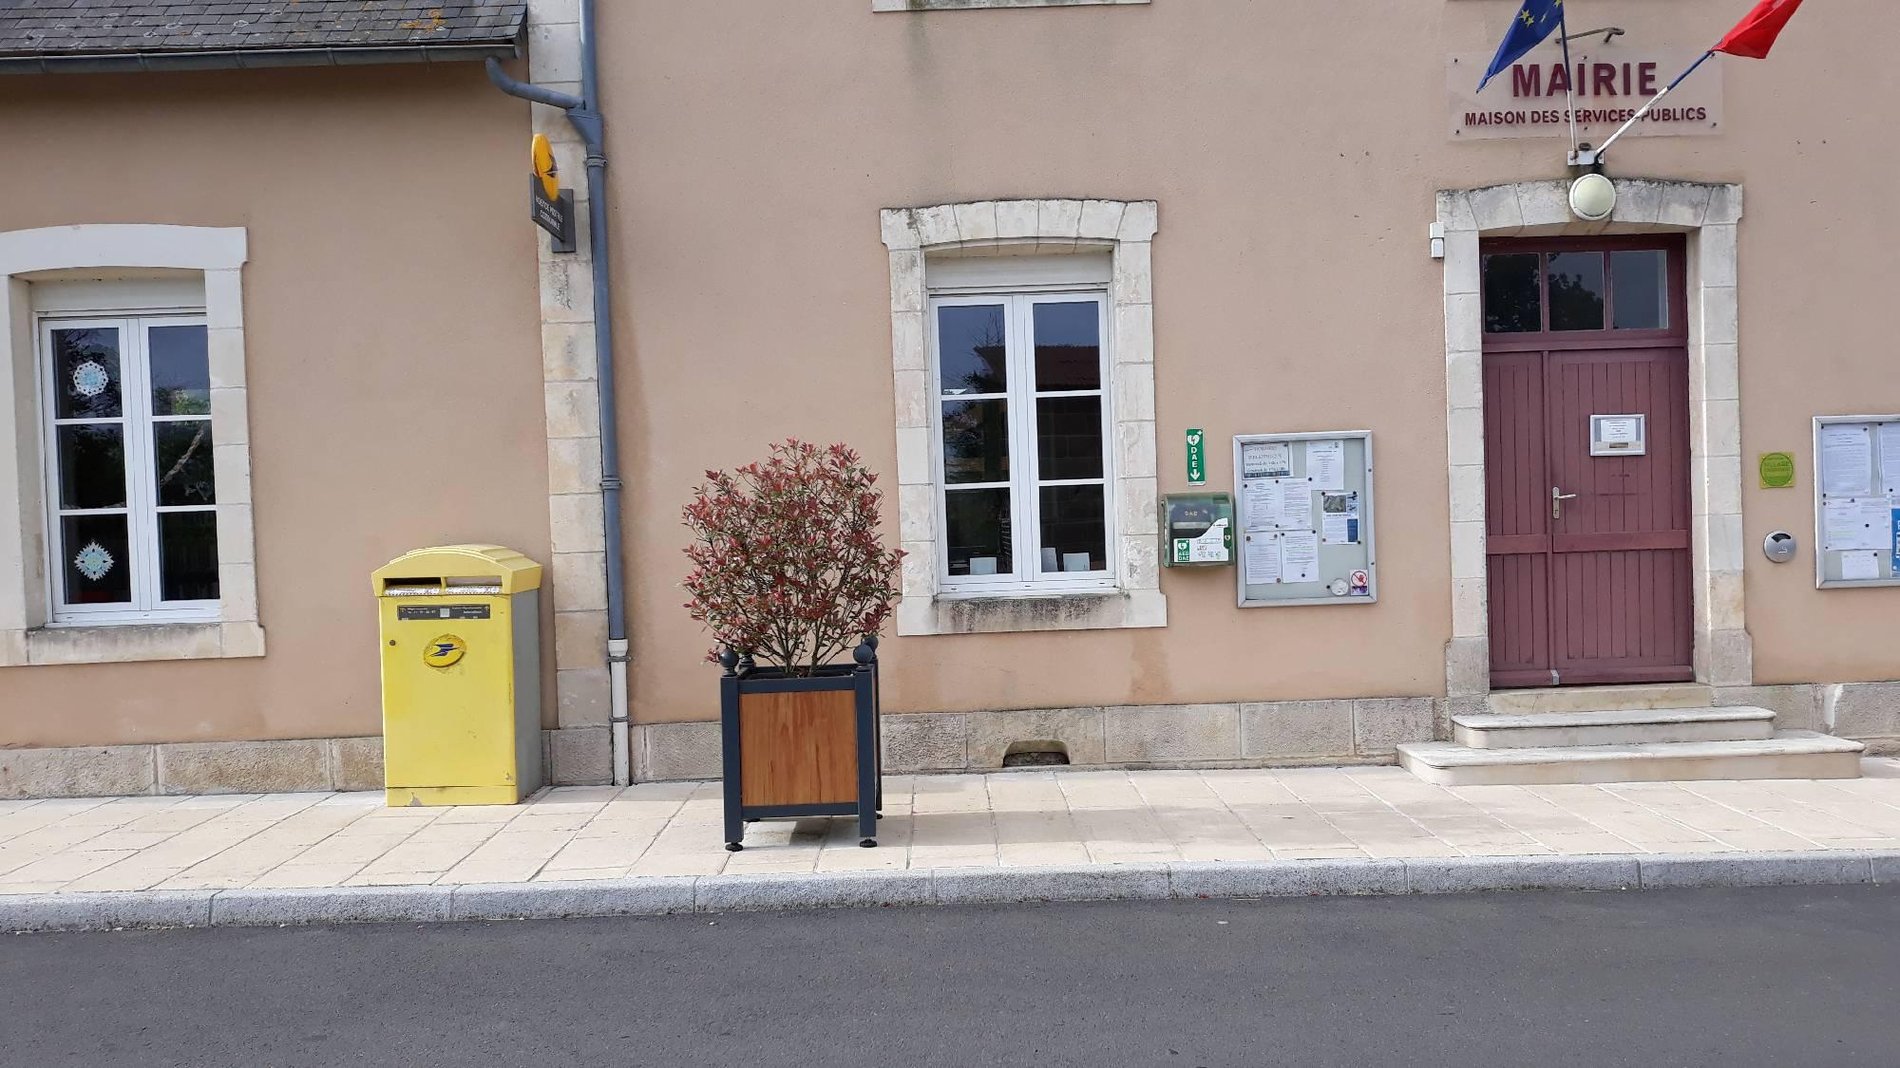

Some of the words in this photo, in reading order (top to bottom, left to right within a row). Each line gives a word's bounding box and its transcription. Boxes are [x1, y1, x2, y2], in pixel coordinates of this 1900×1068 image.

[1512, 62, 1659, 98] MAIRIE
[1465, 110, 1527, 126] MAISON
[1531, 109, 1560, 124] DES
[1564, 108, 1637, 124] SERVICES
[1190, 446, 1198, 468] DAE
